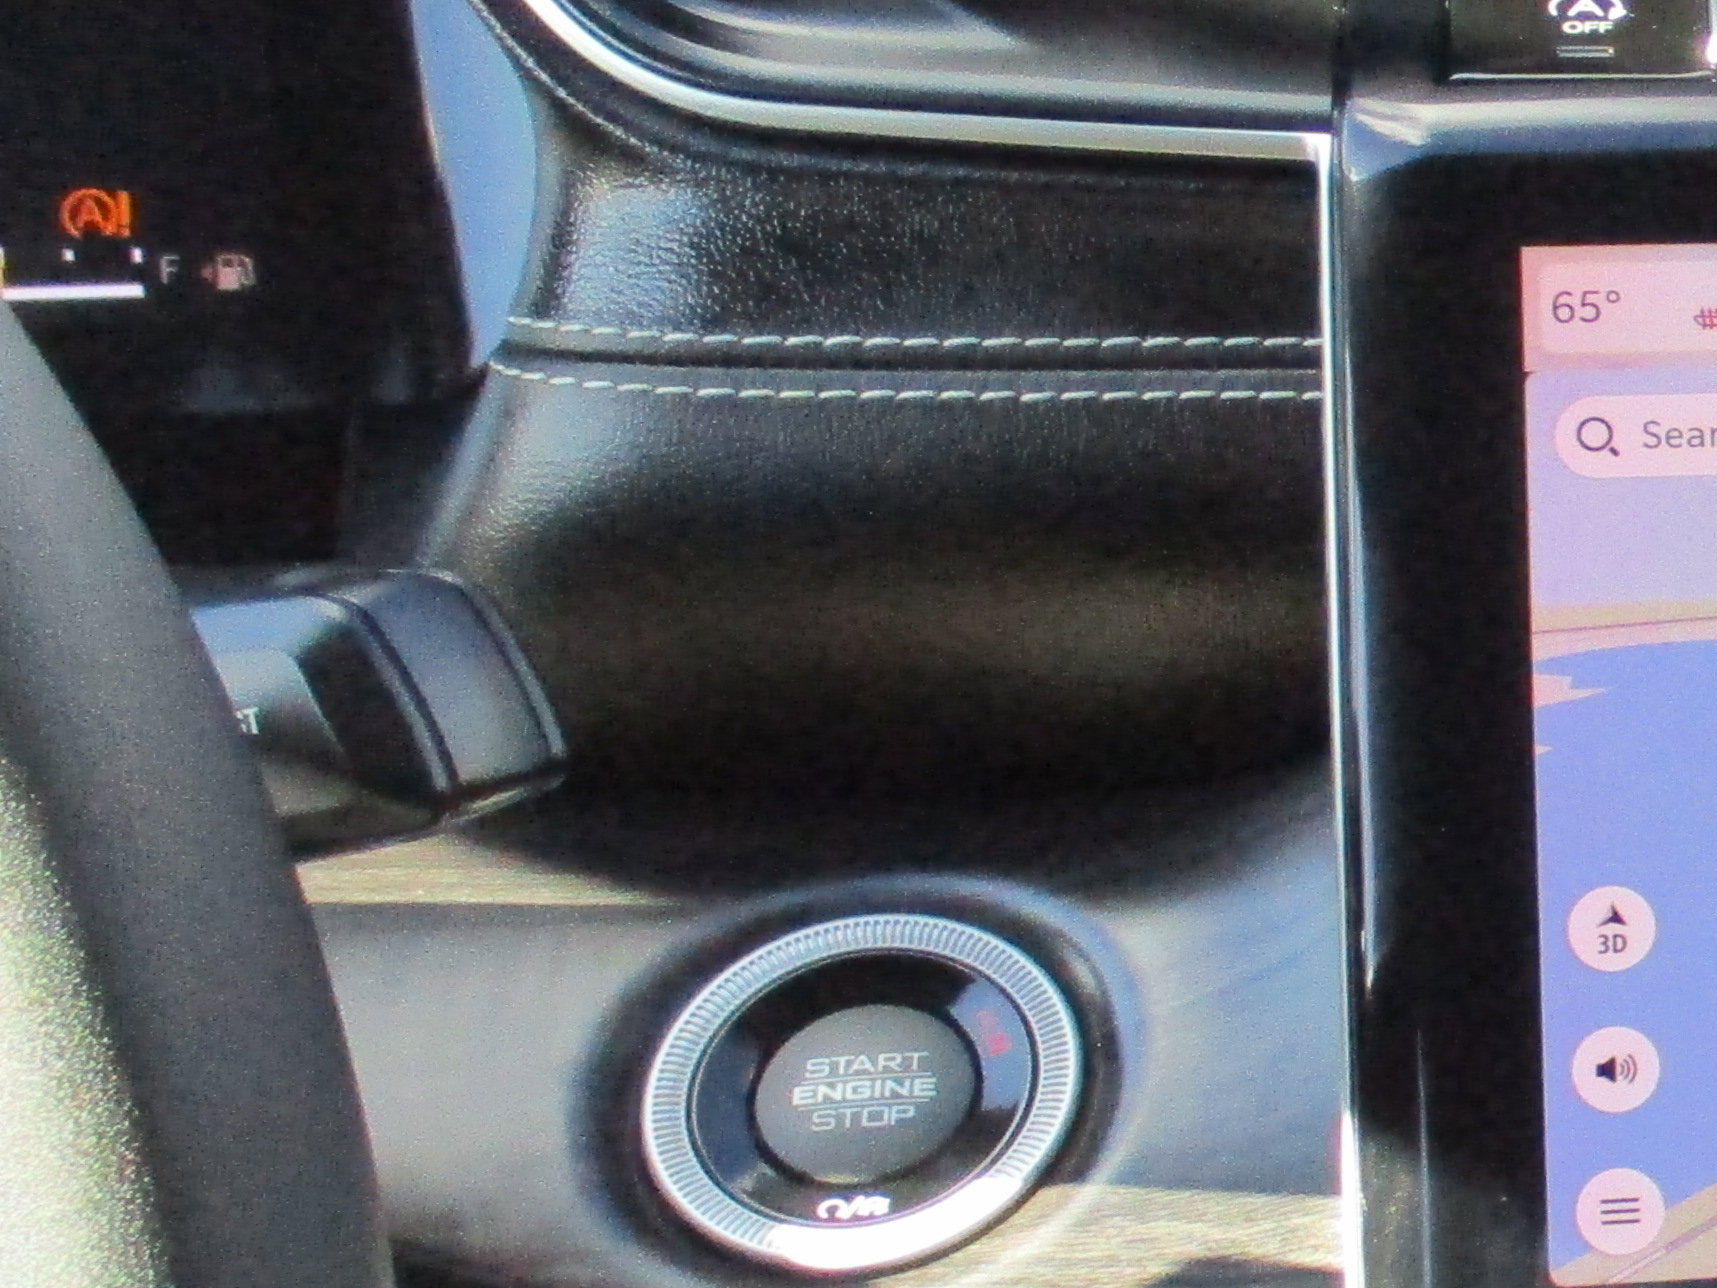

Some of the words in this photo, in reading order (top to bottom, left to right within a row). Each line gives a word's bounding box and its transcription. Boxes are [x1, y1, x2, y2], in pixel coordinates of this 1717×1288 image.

[1561, 20, 1613, 35] OFF
[159, 254, 181, 285] F
[1551, 289, 1621, 324] 65°
[1596, 931, 1629, 956] 3D
[804, 1051, 930, 1079] START
[792, 1076, 938, 1106] ENGINE
[810, 1104, 916, 1131] STOP
